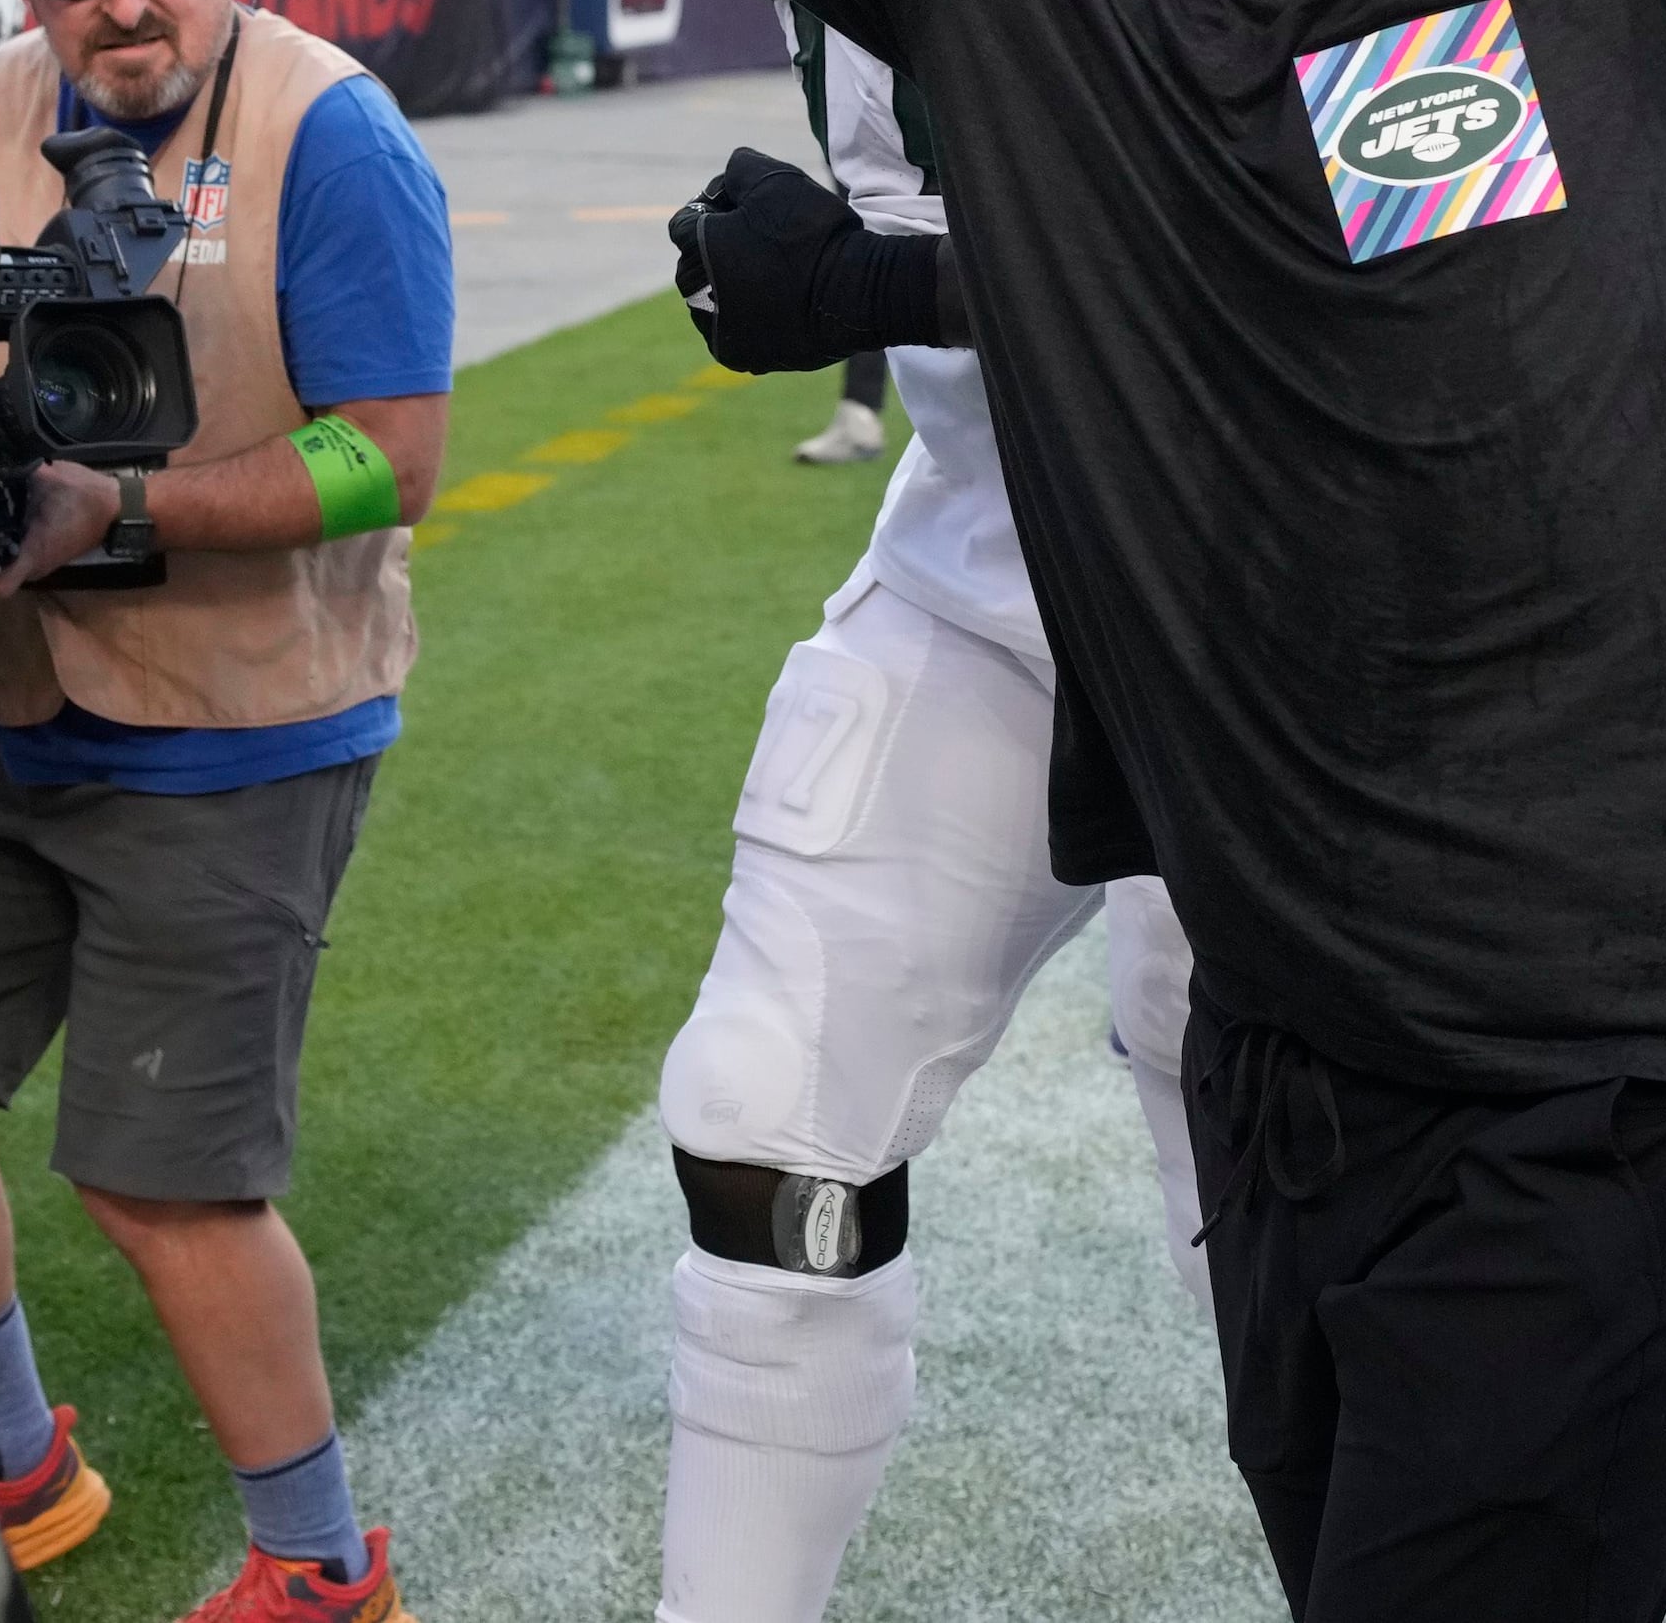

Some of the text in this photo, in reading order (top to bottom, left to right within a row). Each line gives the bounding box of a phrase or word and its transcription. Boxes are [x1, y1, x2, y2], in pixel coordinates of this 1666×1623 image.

[1360, 98, 1500, 159] JETS
[1367, 84, 1479, 126] NEW YORK
[187, 186, 227, 221] NFL
[816, 1186, 836, 1267] DONJOY
